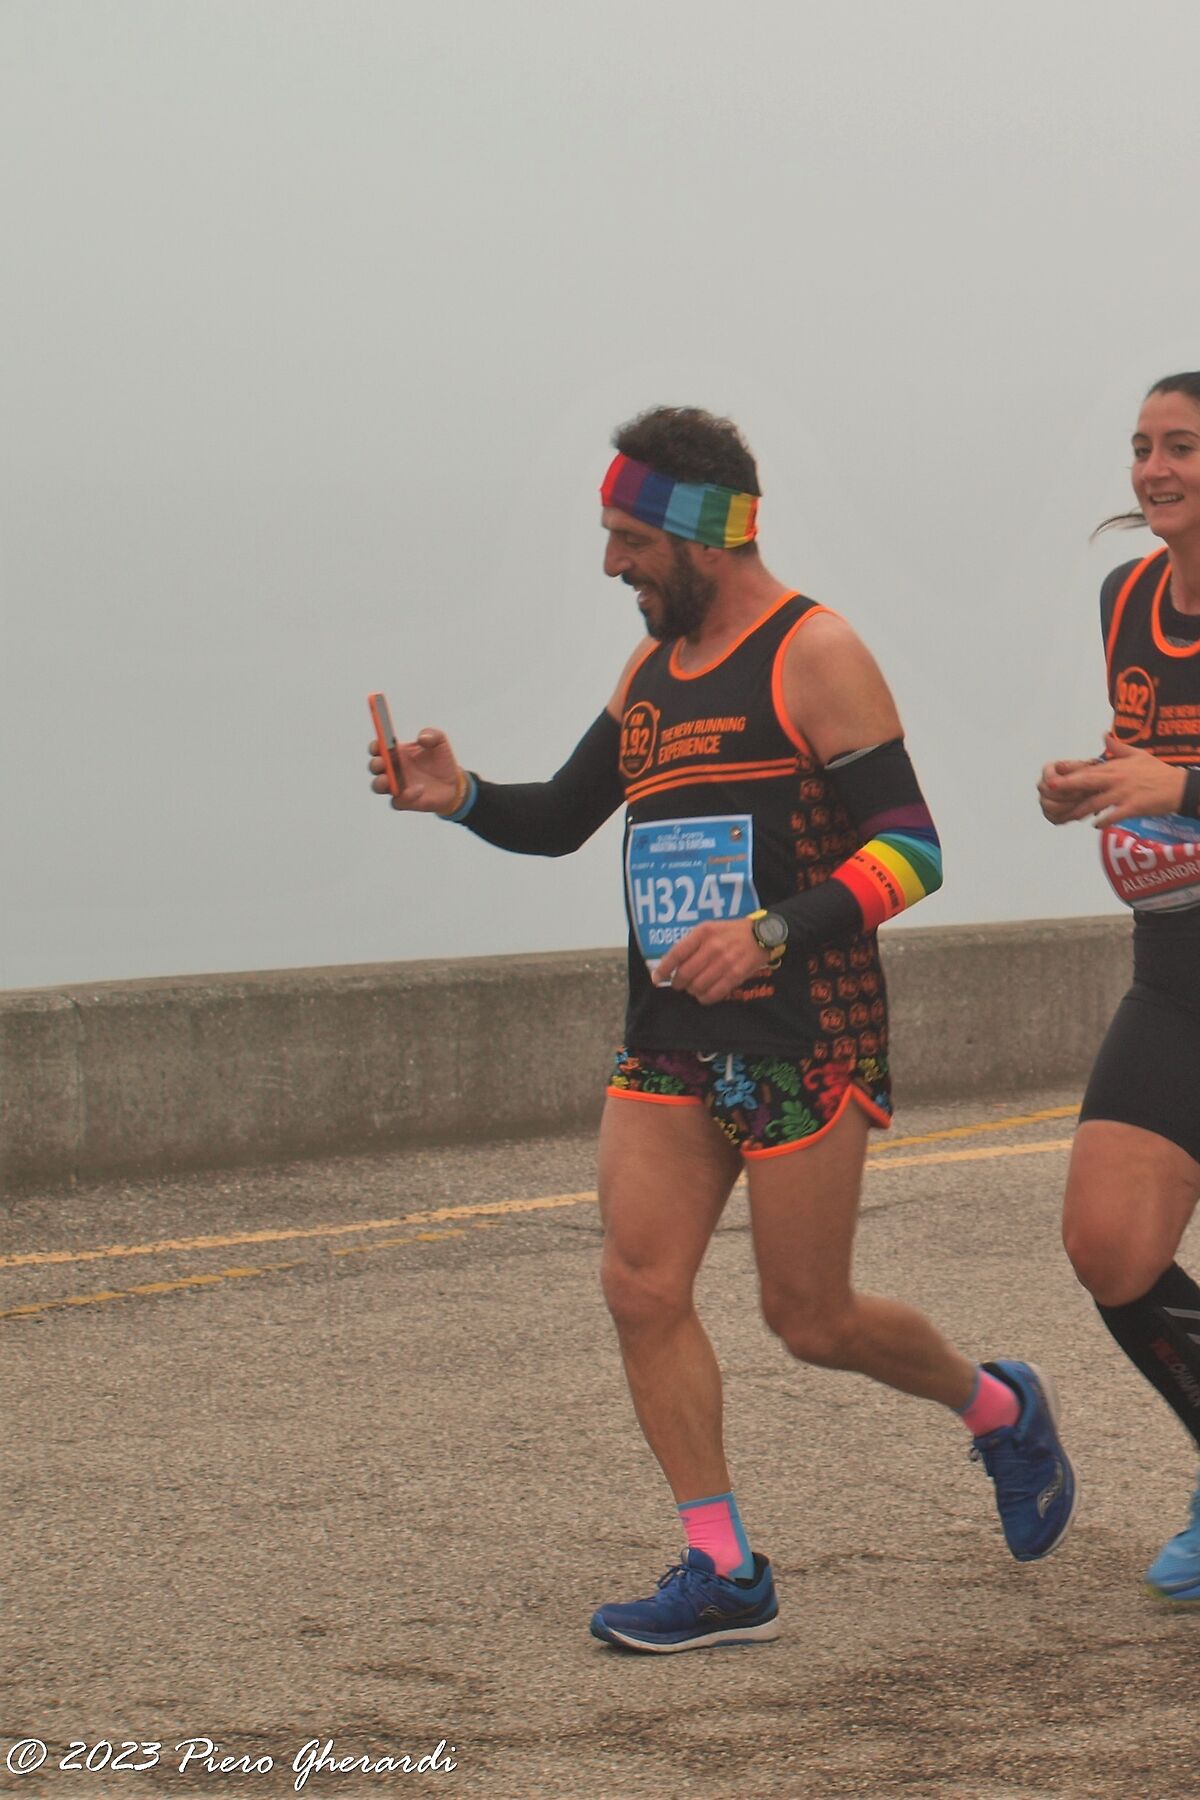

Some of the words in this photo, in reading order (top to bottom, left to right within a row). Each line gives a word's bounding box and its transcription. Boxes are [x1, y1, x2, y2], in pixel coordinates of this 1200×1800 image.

[694, 715, 747, 734] RUNNING
[657, 734, 722, 766] EXPERIENCE
[634, 872, 745, 925] H3247
